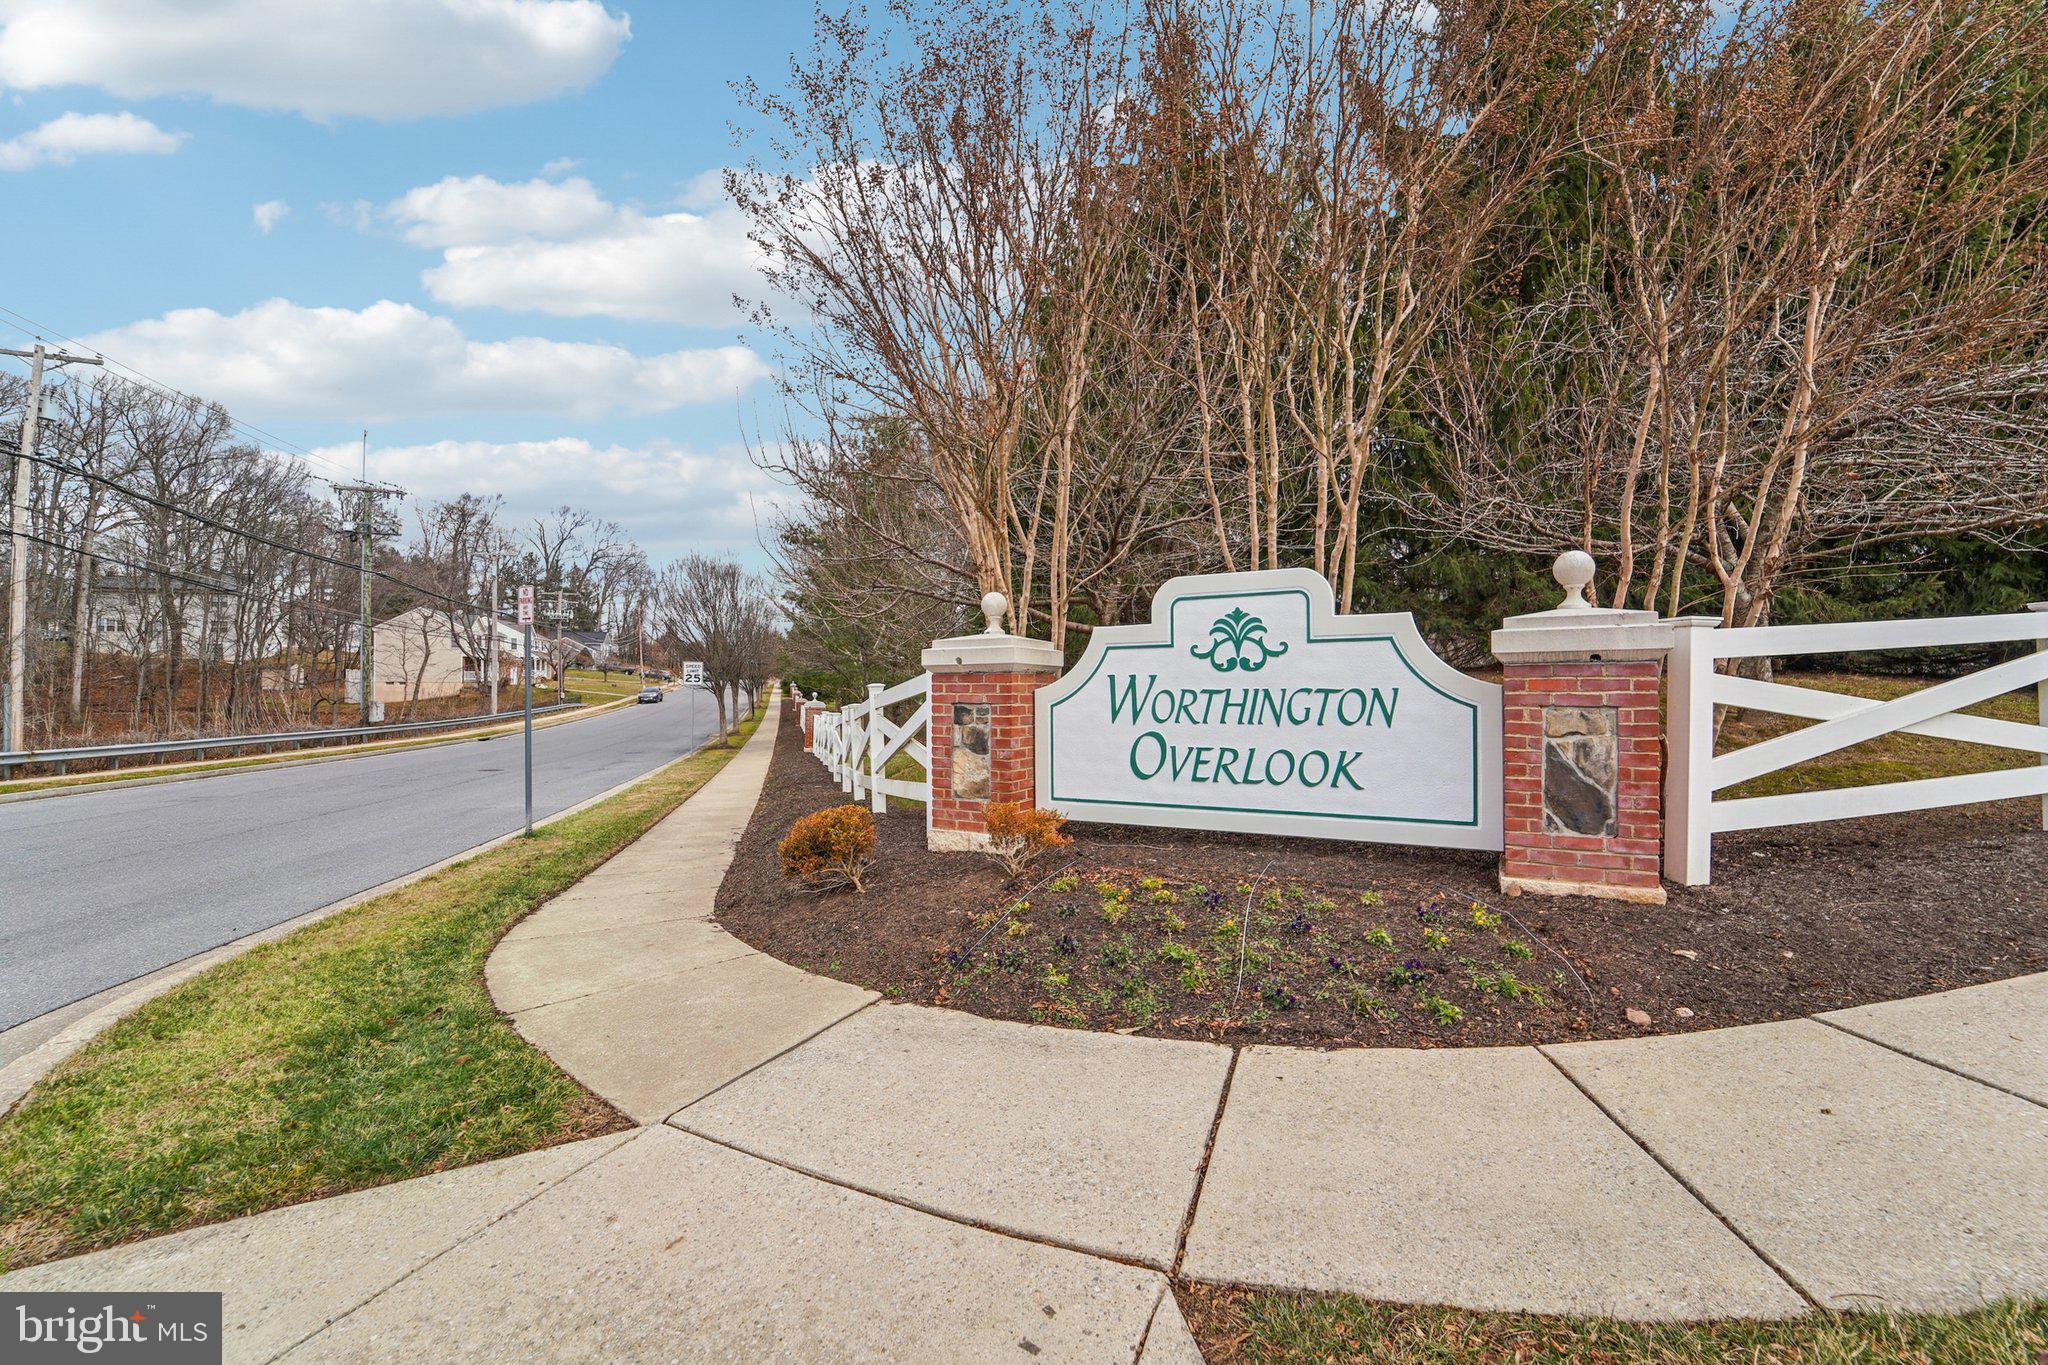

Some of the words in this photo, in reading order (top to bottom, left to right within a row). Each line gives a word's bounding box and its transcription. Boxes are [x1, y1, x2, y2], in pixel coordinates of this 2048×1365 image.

[685, 674, 701, 683] 25
[1107, 674, 1400, 729] WORTHINGTON
[1130, 731, 1365, 791] OVERLOOK
